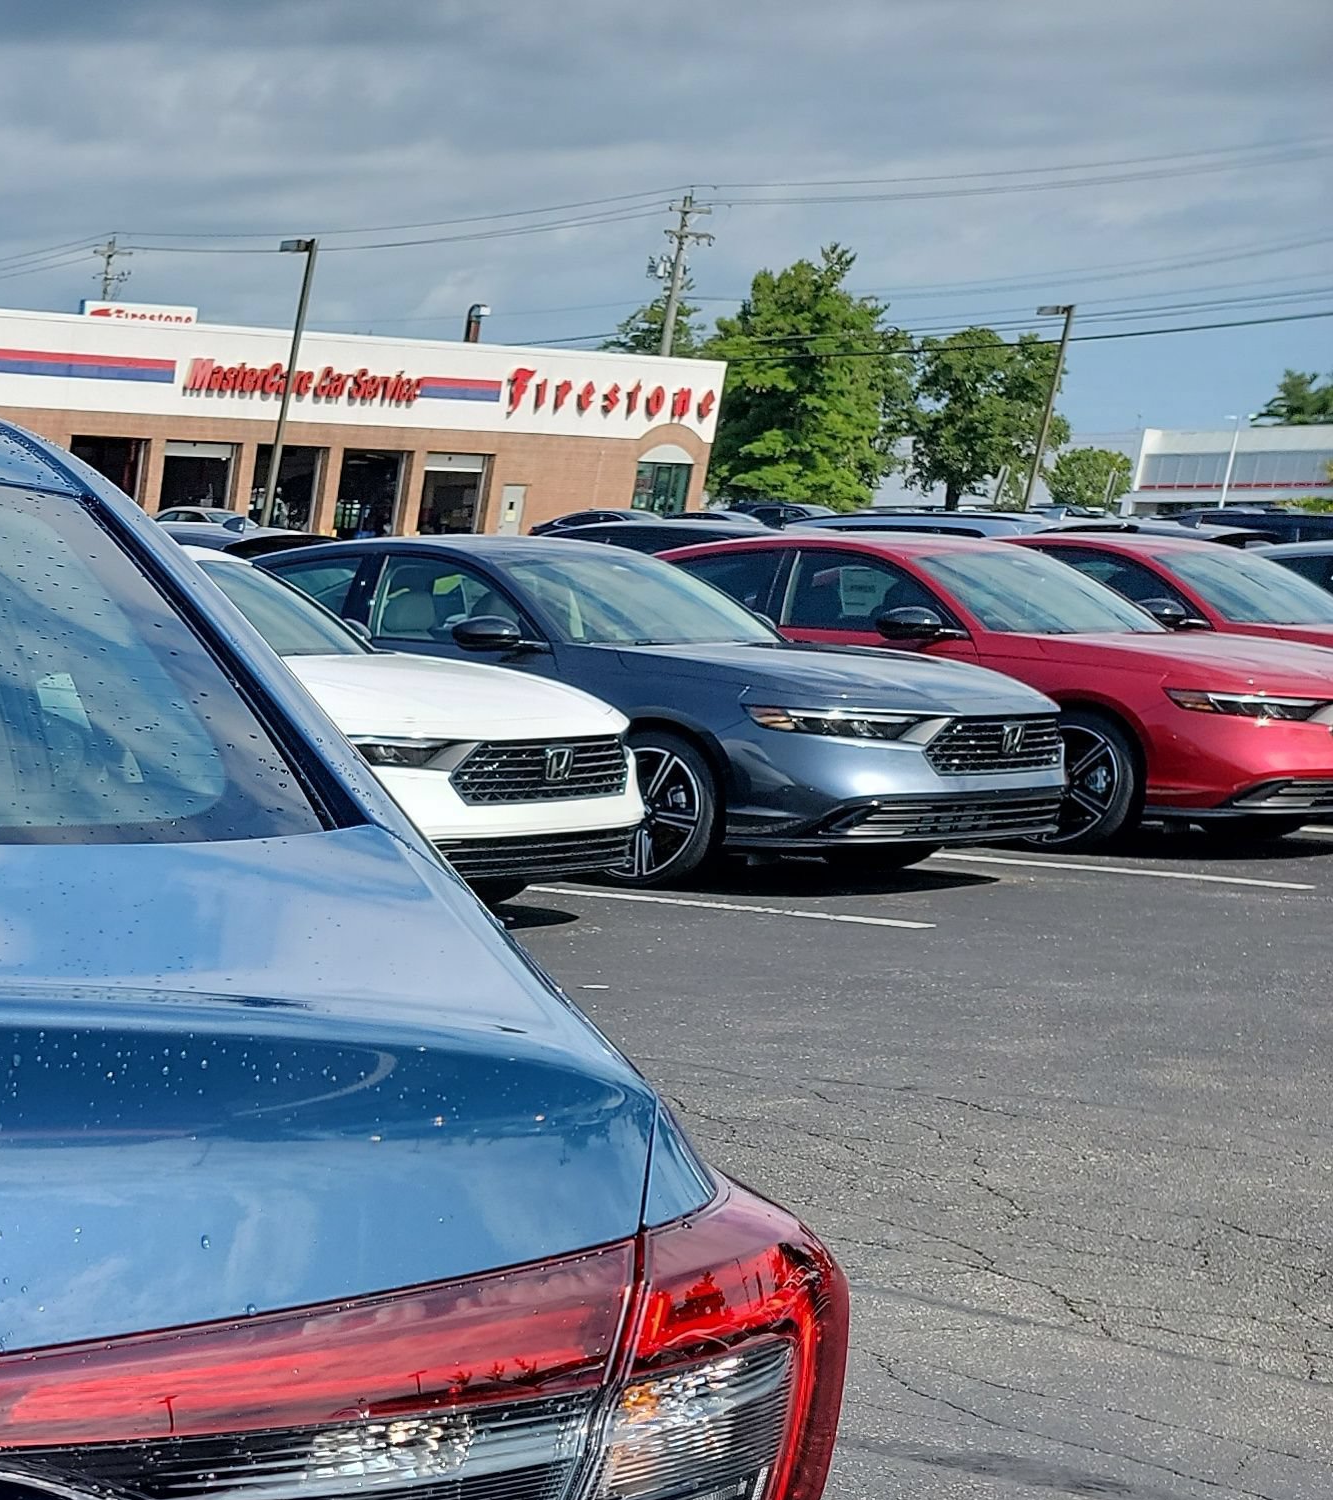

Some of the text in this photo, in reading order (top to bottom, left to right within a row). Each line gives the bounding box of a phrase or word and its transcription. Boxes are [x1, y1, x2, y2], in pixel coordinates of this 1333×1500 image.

[315, 366, 348, 397] Car
[349, 368, 420, 401] Service
[507, 367, 716, 419] Firestone
